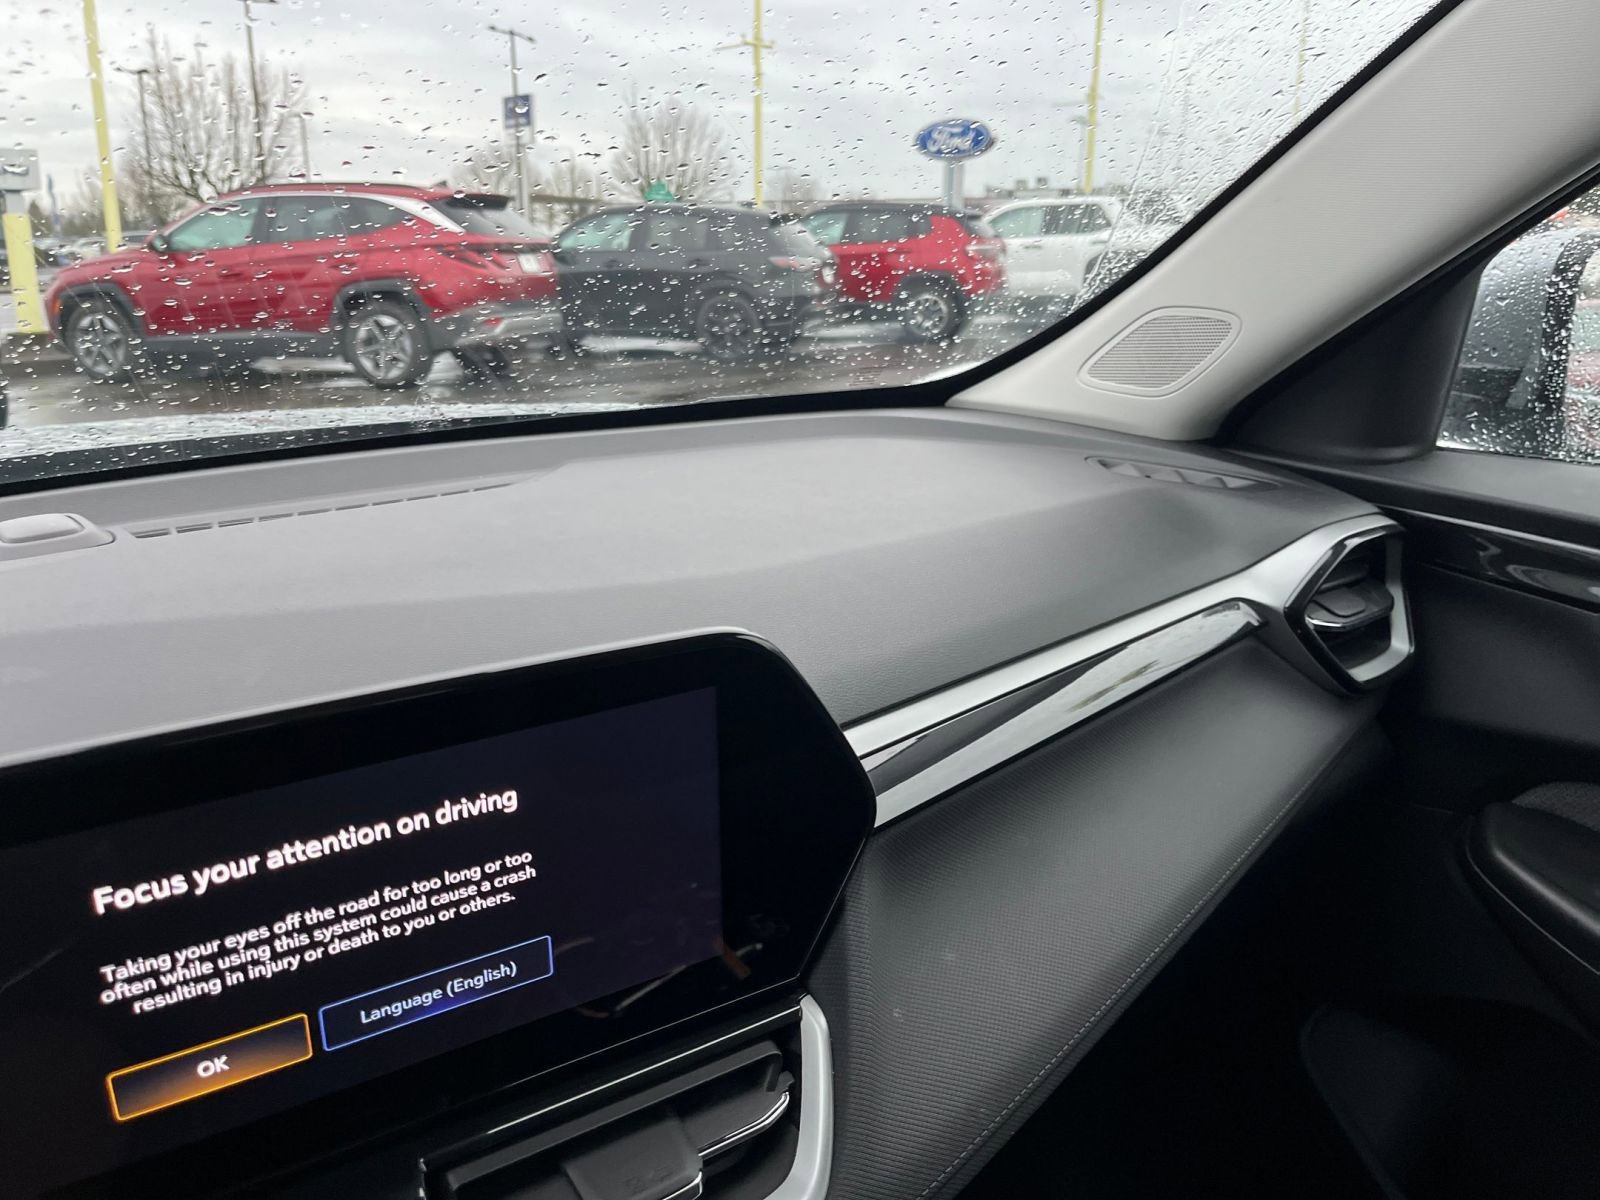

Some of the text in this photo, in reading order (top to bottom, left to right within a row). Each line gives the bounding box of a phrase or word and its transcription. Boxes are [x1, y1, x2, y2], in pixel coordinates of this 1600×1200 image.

[926, 125, 977, 152] Ford
[92, 789, 518, 915] Focus your attention on driving
[100, 852, 533, 983] Taking your eyes off the road for too long or too
[100, 865, 537, 1004] often while using this system could cause a crash
[132, 890, 516, 1015] resulting in injury or death to you or others.
[360, 961, 517, 1024] Language (English)
[196, 1054, 230, 1078] OK
